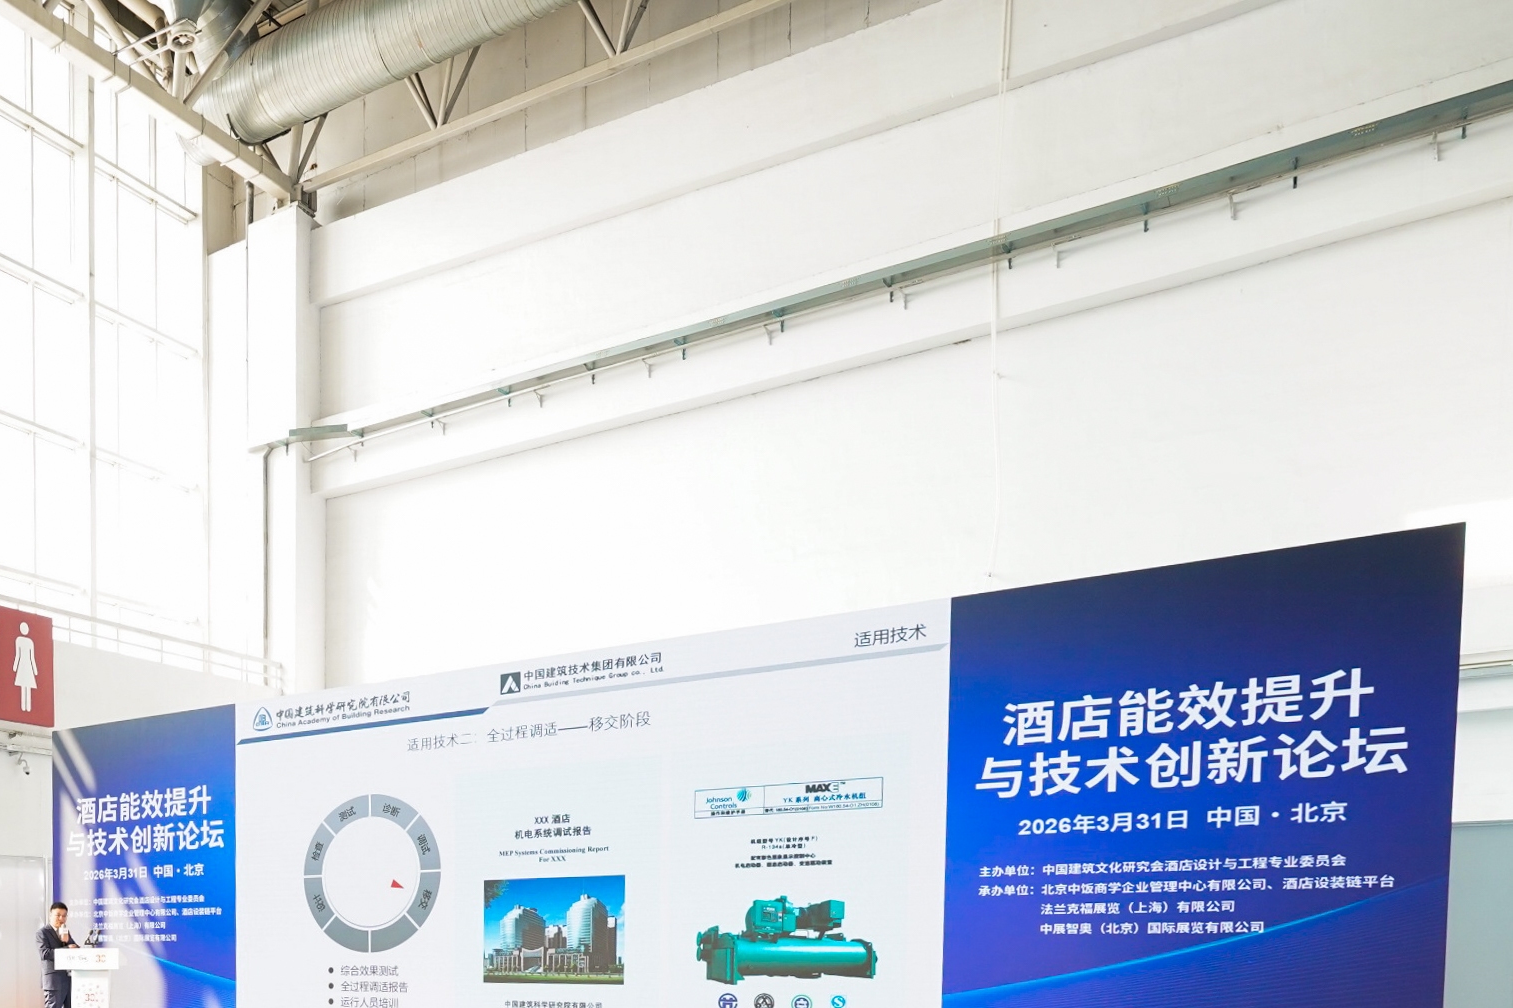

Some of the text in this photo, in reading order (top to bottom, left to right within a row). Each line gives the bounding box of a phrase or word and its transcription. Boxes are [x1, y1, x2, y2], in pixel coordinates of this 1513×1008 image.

[854, 623, 927, 648] 适用技术
[524, 652, 662, 681] 中国建筑技术集团有限公司
[573, 674, 606, 684] Technique
[609, 671, 628, 679] Group
[276, 691, 410, 721] 中国建筑科学研究院有限公司
[1002, 667, 1375, 746] 酒店能效提升
[276, 720, 296, 729] China
[298, 716, 330, 727] Academy
[342, 709, 371, 720] Building
[374, 705, 410, 716] Research
[975, 727, 1409, 798] 与技术创新论坛
[76, 785, 212, 825] 酒店能效提升
[705, 796, 732, 804] Johnson
[710, 802, 737, 810] Controls
[382, 803, 401, 817] 诊断
[534, 814, 571, 824] XXX 酒店
[1018, 810, 1189, 836] 2026年3月31日
[67, 820, 225, 857] 与技术创新论坛
[514, 825, 592, 840] 机电系统调试报告
[311, 842, 325, 861] 检查
[514, 849, 538, 857] Systems
[539, 846, 586, 855] Commissioning
[587, 845, 609, 855] Report
[83, 866, 147, 880] 2026年3月31日
[340, 965, 399, 977] 综合效果测试
[340, 981, 408, 993] 全过程调适报告
[340, 996, 399, 1008] 运行人员培训
